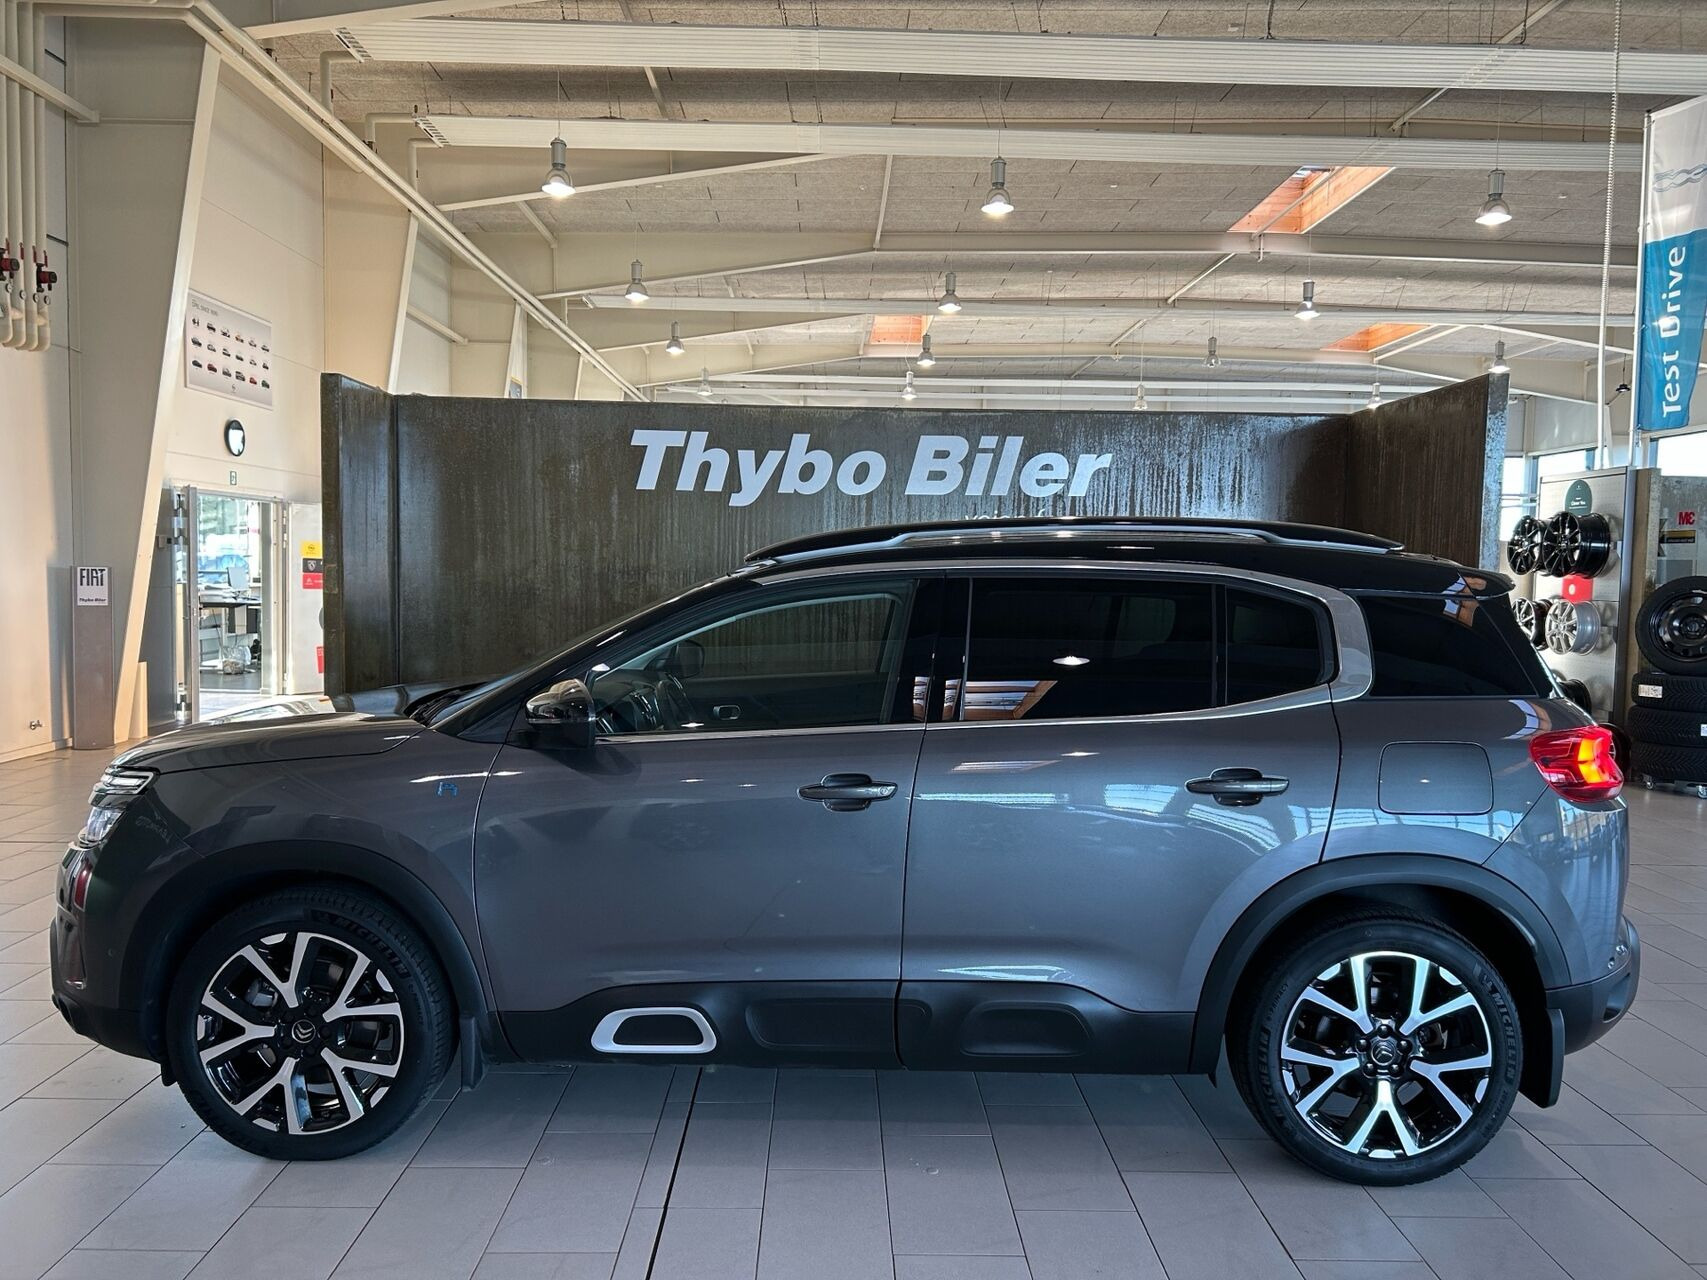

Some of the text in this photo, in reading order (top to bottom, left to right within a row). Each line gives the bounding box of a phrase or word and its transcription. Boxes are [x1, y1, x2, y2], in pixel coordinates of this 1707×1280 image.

[1659, 246, 1686, 418] Test Drive
[630, 429, 1113, 507] Thybo Biler
[80, 568, 106, 586] FIAT
[1258, 1030, 1284, 1118] MICHELIN
[1492, 991, 1517, 1081] MICHELIN
